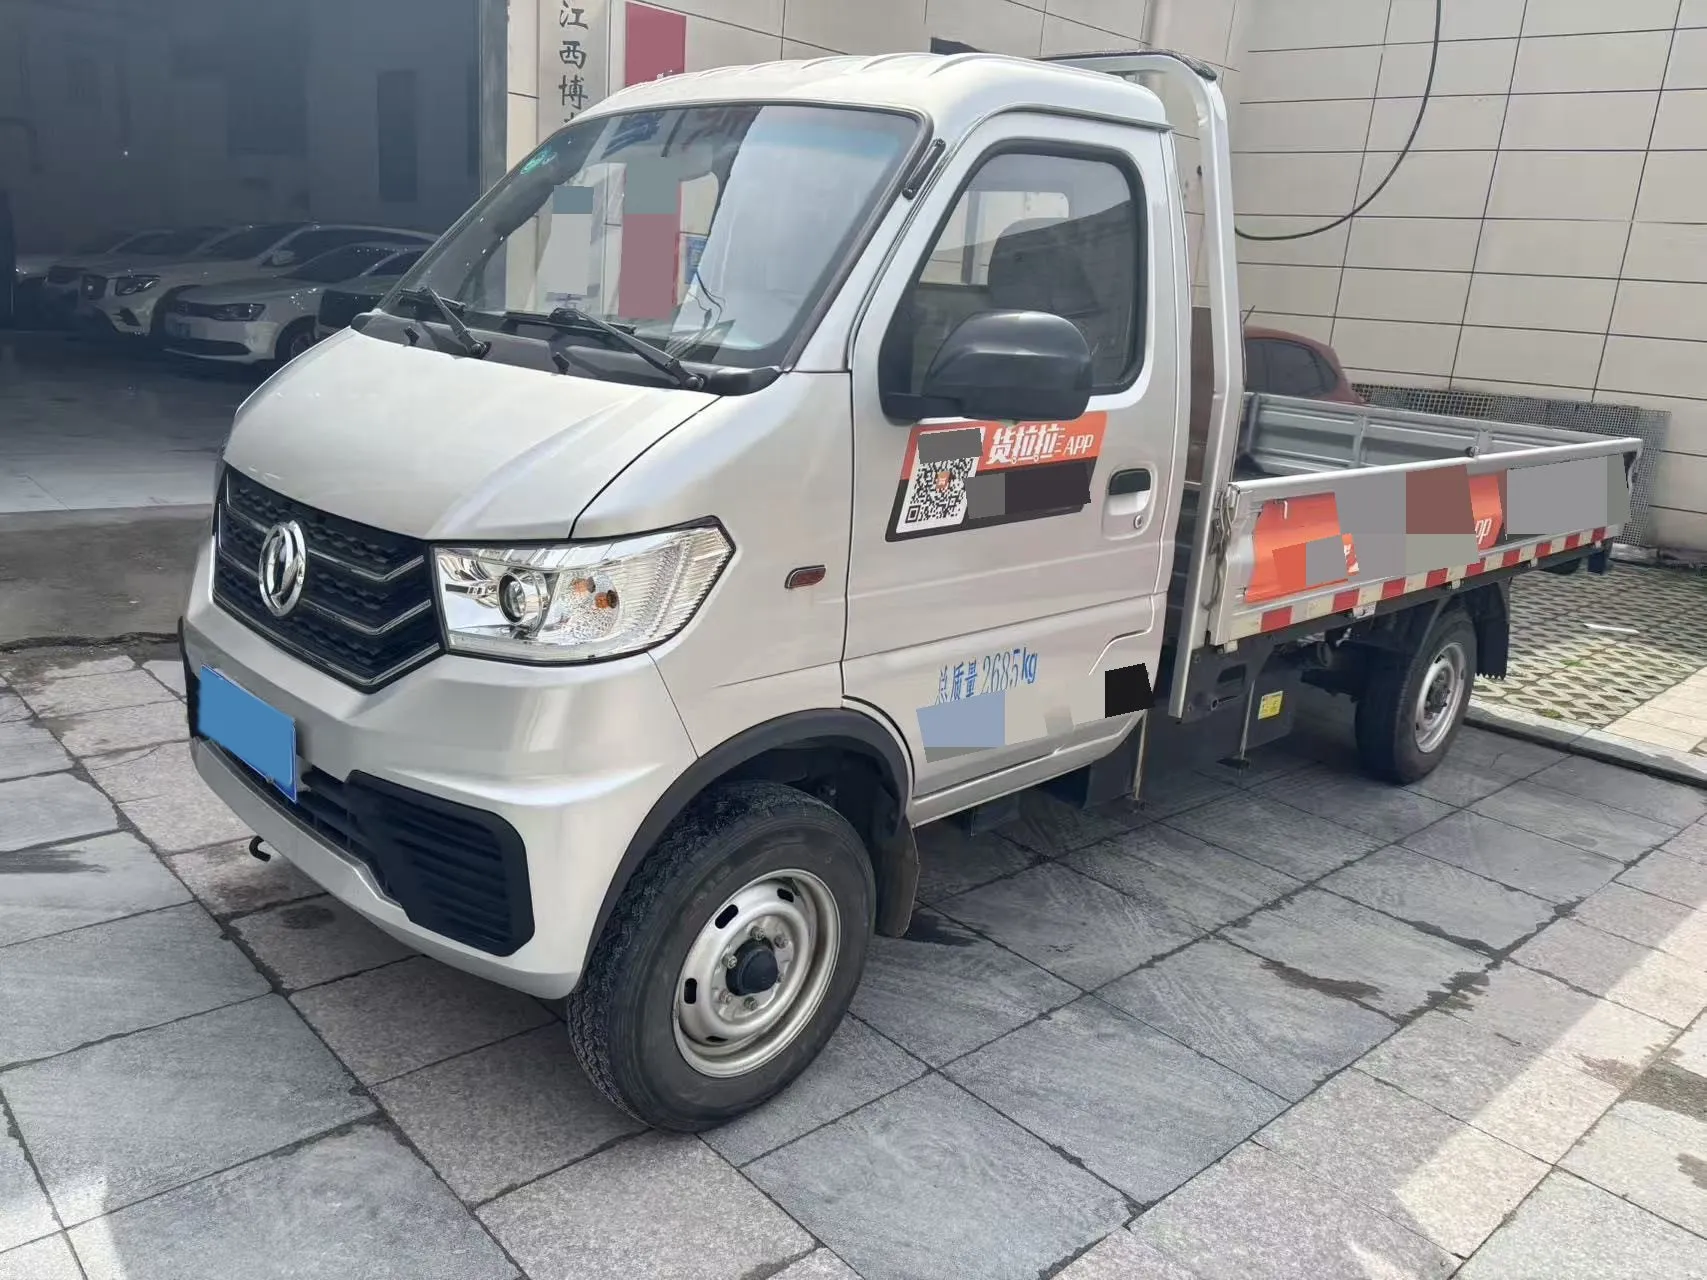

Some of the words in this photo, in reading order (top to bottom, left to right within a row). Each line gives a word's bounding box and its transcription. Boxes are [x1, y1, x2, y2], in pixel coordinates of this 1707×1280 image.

[558, 0, 589, 124] 江西博
[986, 424, 1060, 464] 货拉拉
[1063, 434, 1094, 455] APP
